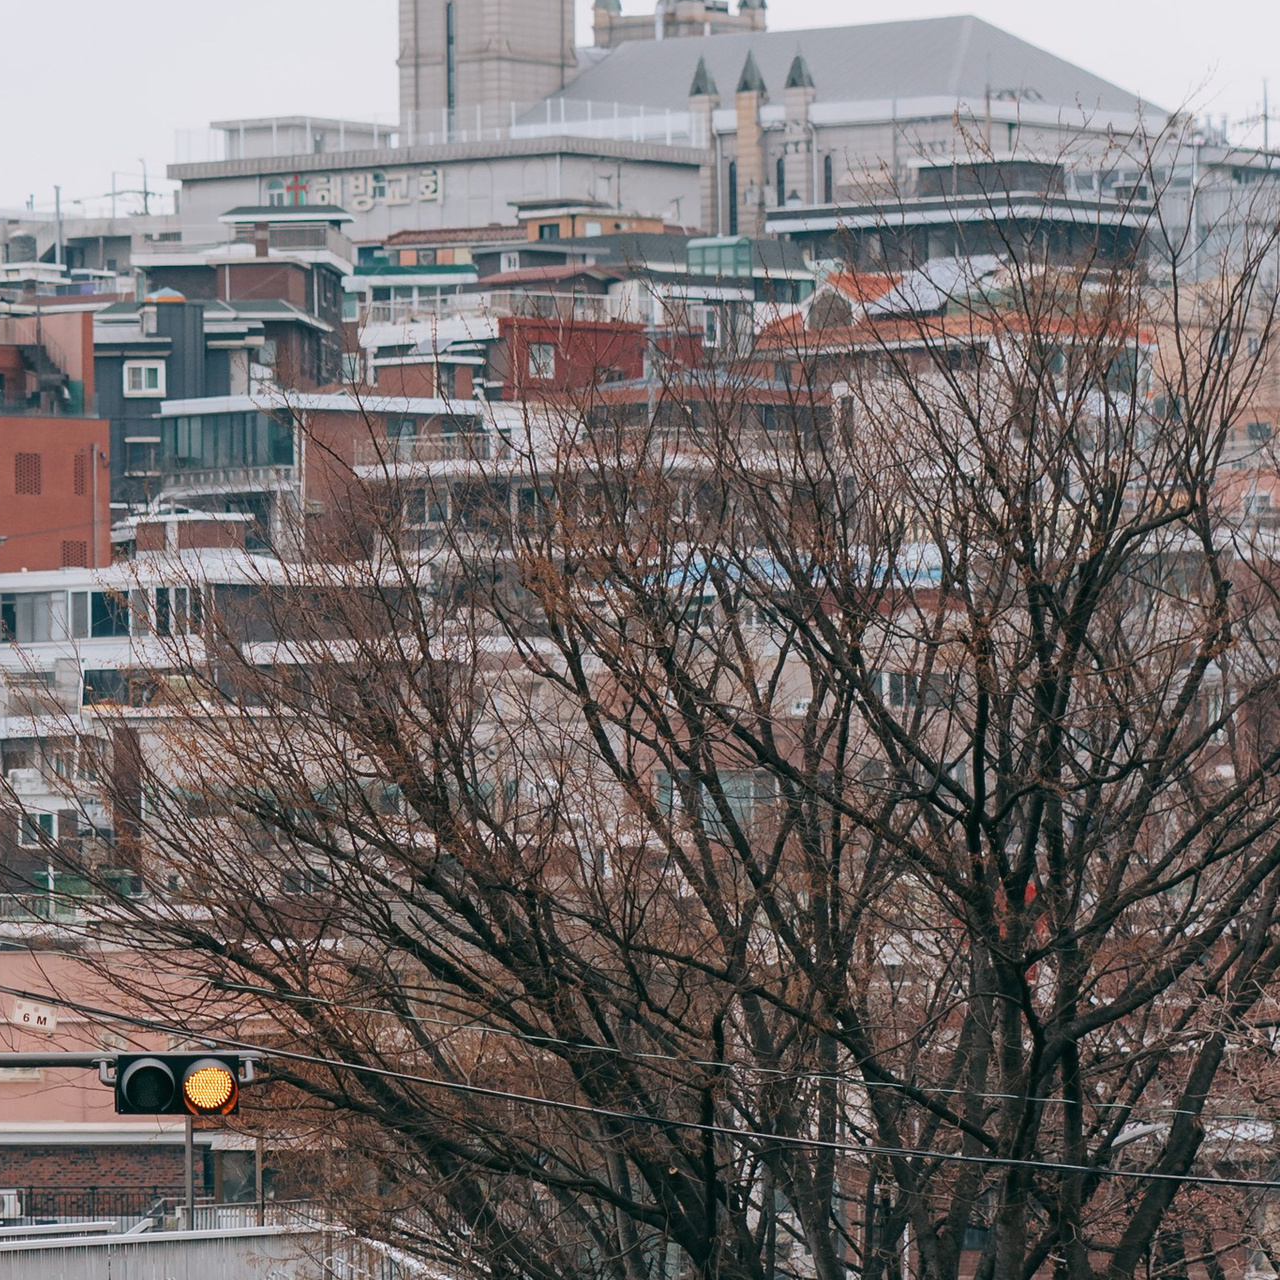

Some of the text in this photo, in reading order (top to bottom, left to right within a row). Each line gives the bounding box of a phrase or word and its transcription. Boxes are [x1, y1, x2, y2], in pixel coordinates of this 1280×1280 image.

[315, 168, 444, 212] 해방교회
[23, 1013, 47, 1026] 6 M
